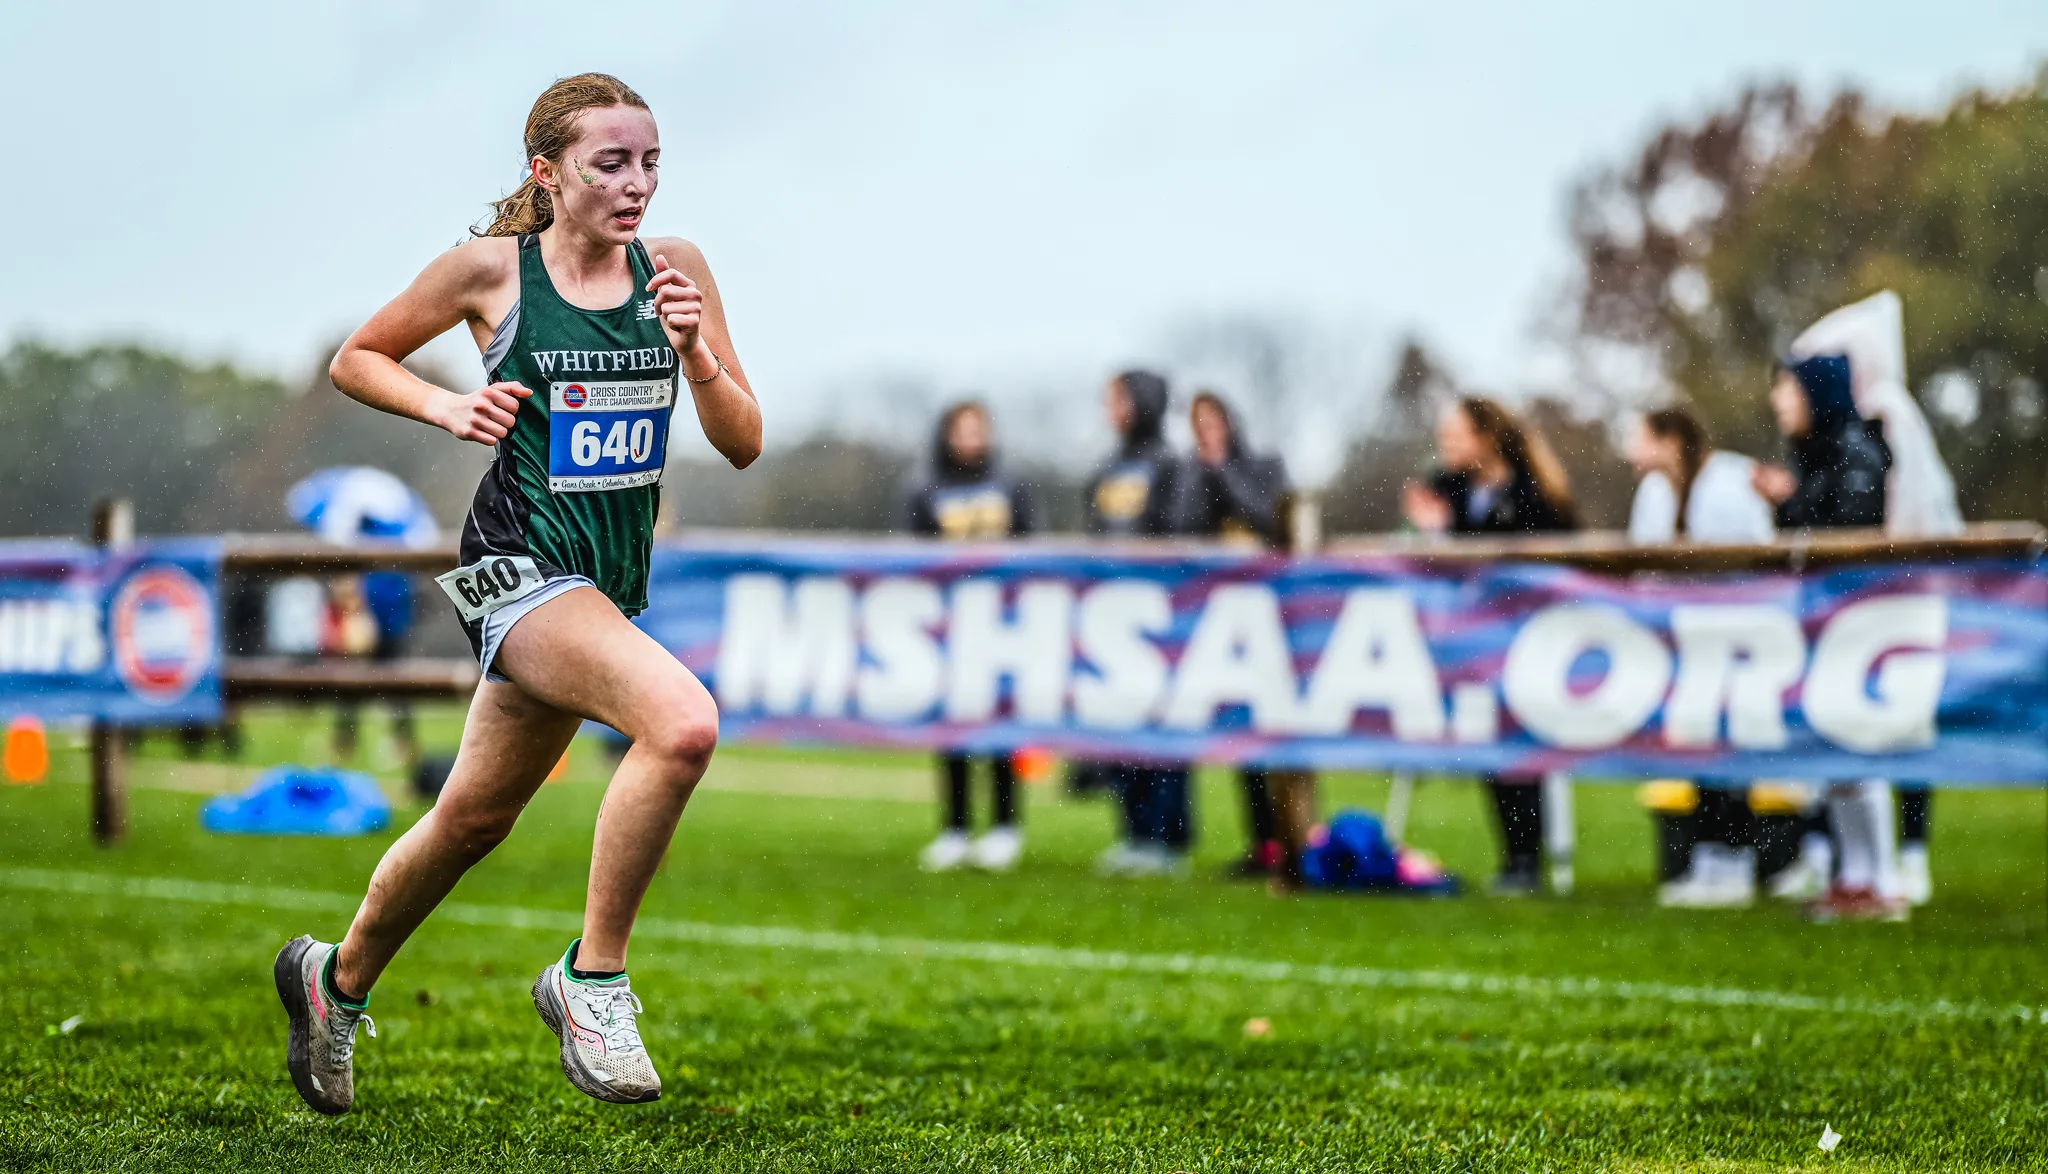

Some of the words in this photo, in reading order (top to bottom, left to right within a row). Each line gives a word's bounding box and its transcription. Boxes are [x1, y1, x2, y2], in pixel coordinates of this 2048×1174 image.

[531, 346, 674, 373] WHITFIELD
[589, 398, 609, 407] STATE
[610, 397, 654, 407] CHAMPIONSHIP
[591, 386, 616, 398] CROSS
[618, 385, 654, 397] COUNTRY
[571, 418, 654, 467] 640
[561, 479, 577, 491] Gans
[578, 479, 596, 489] Creek
[455, 557, 522, 609] 640
[718, 573, 1948, 755] MSHSAA.ORG
